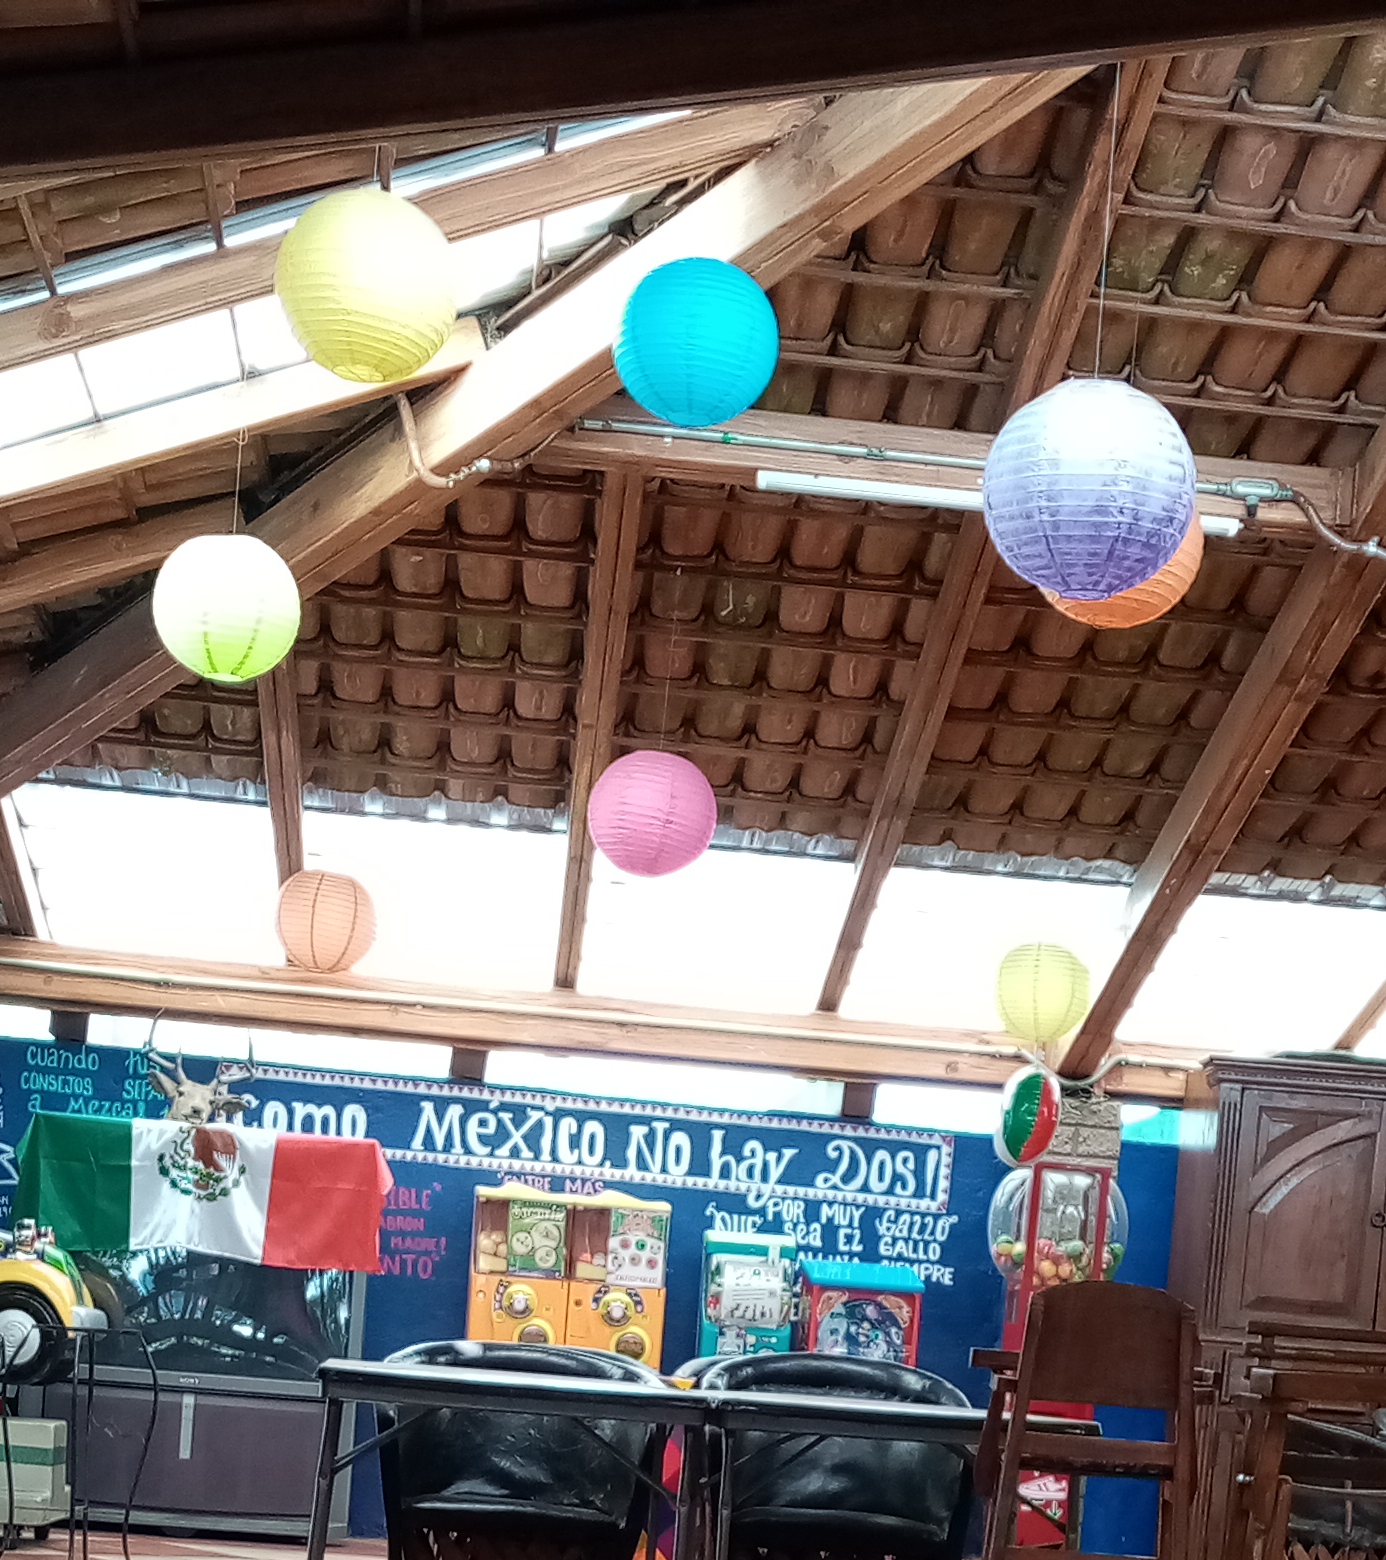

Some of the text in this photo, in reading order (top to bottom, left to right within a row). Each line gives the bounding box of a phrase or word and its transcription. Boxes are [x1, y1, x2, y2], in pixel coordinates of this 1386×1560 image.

[20, 1070, 93, 1096] CONSEJOS
[766, 1198, 806, 1223] POR
[821, 1203, 866, 1227] MUY
[879, 1236, 941, 1262] GALLO
